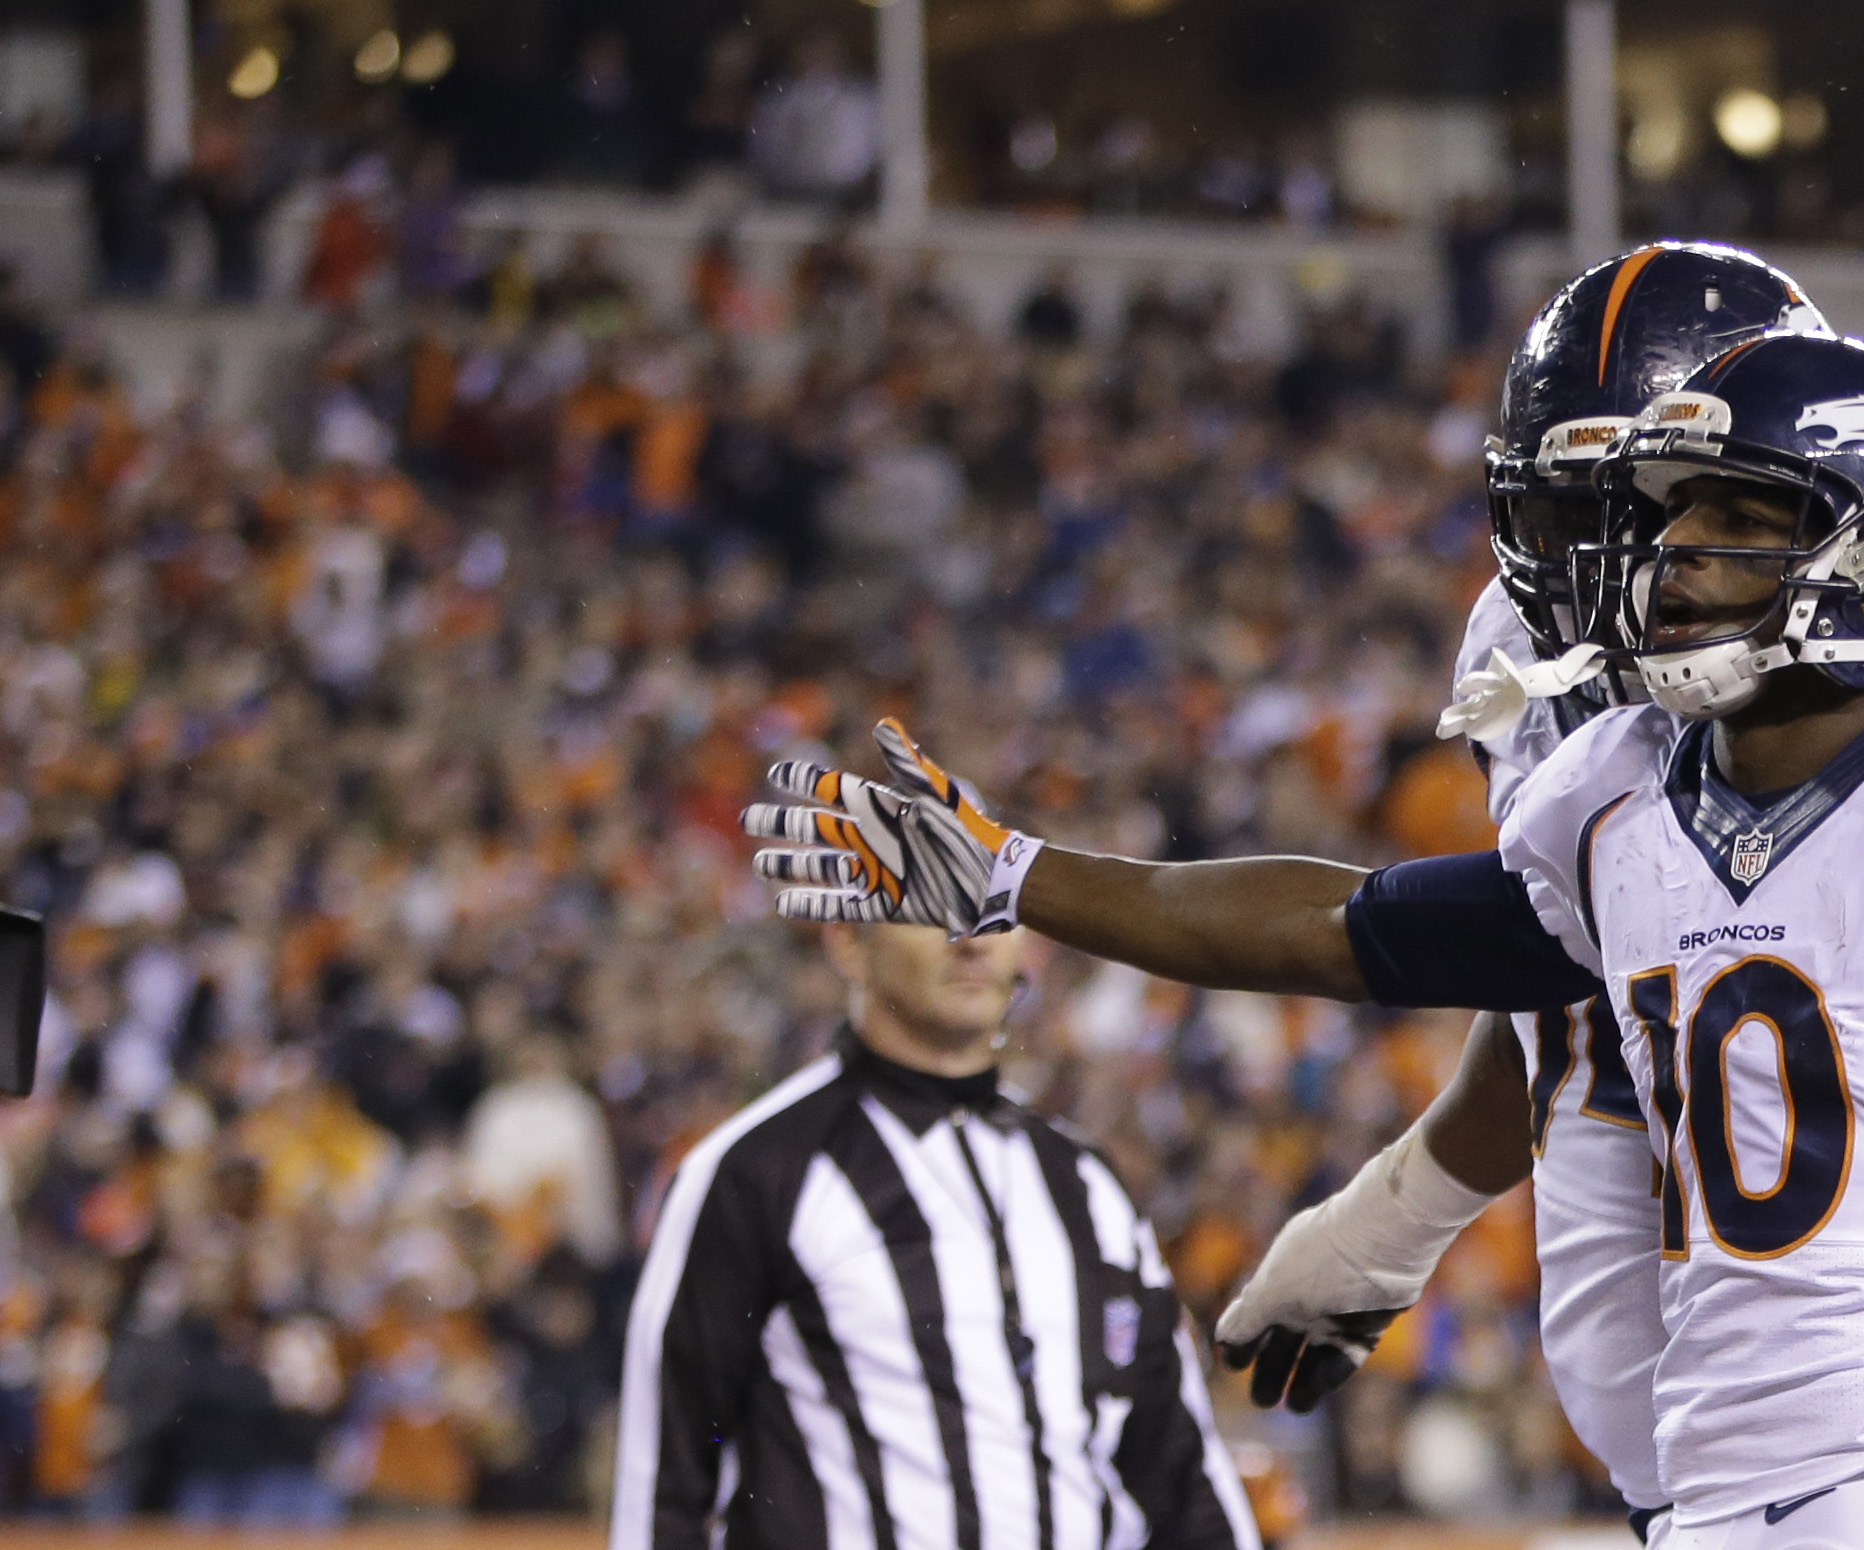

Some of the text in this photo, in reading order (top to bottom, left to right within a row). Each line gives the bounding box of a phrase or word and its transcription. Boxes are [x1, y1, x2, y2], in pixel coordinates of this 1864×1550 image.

[1567, 426, 1618, 446] BRONCO
[1737, 853, 1764, 875] NFL
[1679, 925, 1785, 949] BRONCOS
[1627, 953, 1855, 1260] 10
